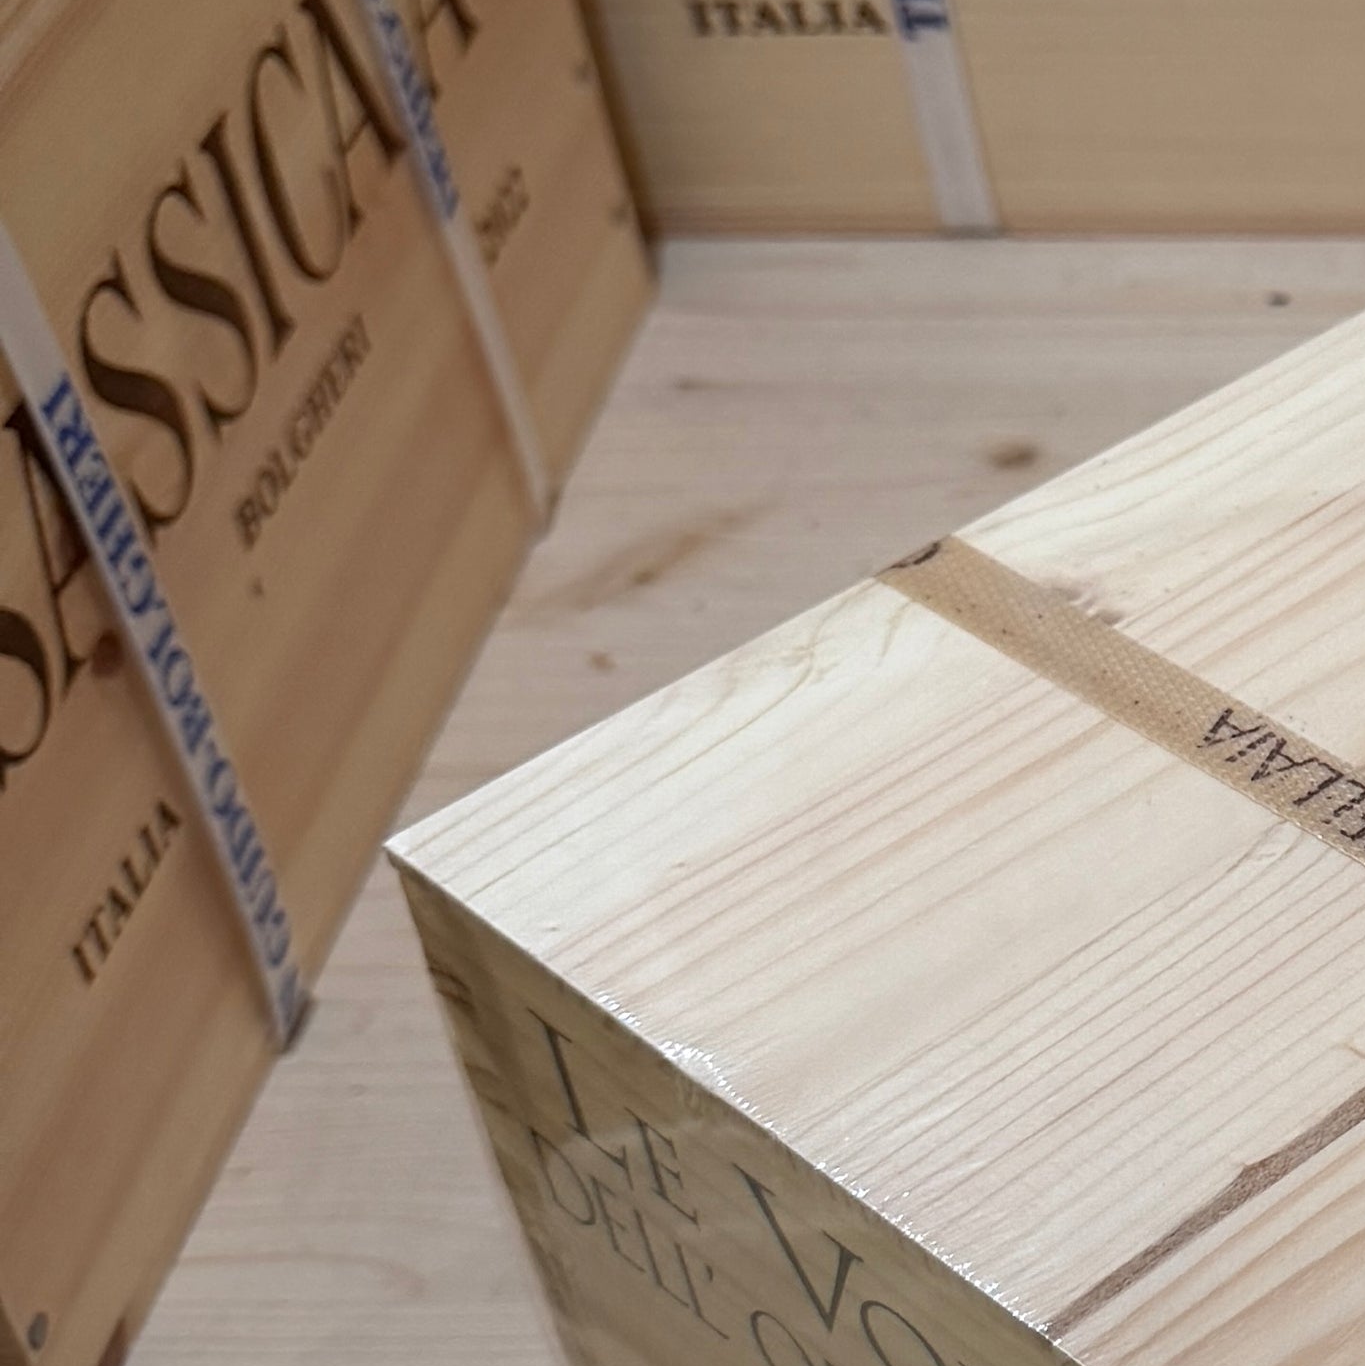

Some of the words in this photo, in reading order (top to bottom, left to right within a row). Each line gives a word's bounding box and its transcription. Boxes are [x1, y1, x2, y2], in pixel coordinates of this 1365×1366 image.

[234, 313, 373, 553] BOLGHERI
[70, 800, 182, 985] ITALIA
[527, 1007, 699, 1232] LE
